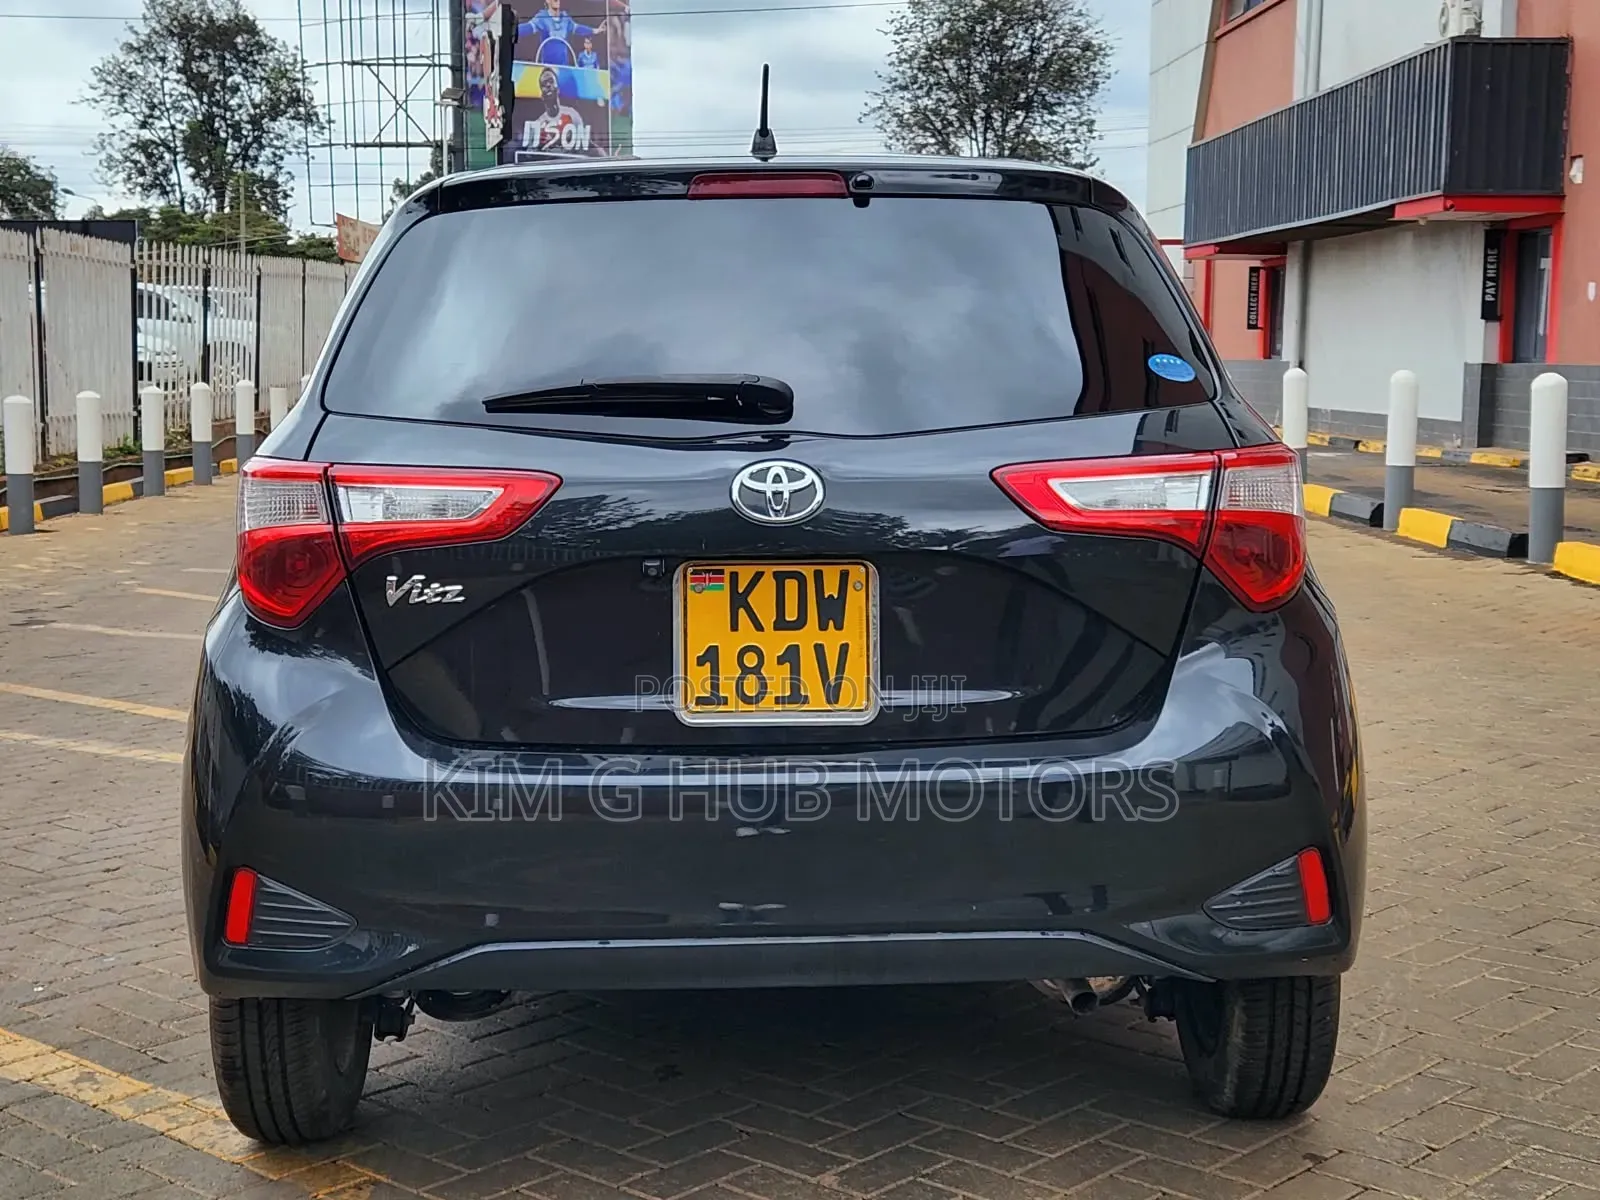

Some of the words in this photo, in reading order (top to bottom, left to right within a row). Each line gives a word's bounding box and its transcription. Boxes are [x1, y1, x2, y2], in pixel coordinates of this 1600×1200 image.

[1486, 248, 1498, 277] HERE
[1485, 280, 1497, 301] PAY
[1249, 292, 1258, 325] COLLECT
[386, 574, 466, 607] Vitz
[728, 569, 850, 632] KDW
[695, 642, 850, 706] 181V
